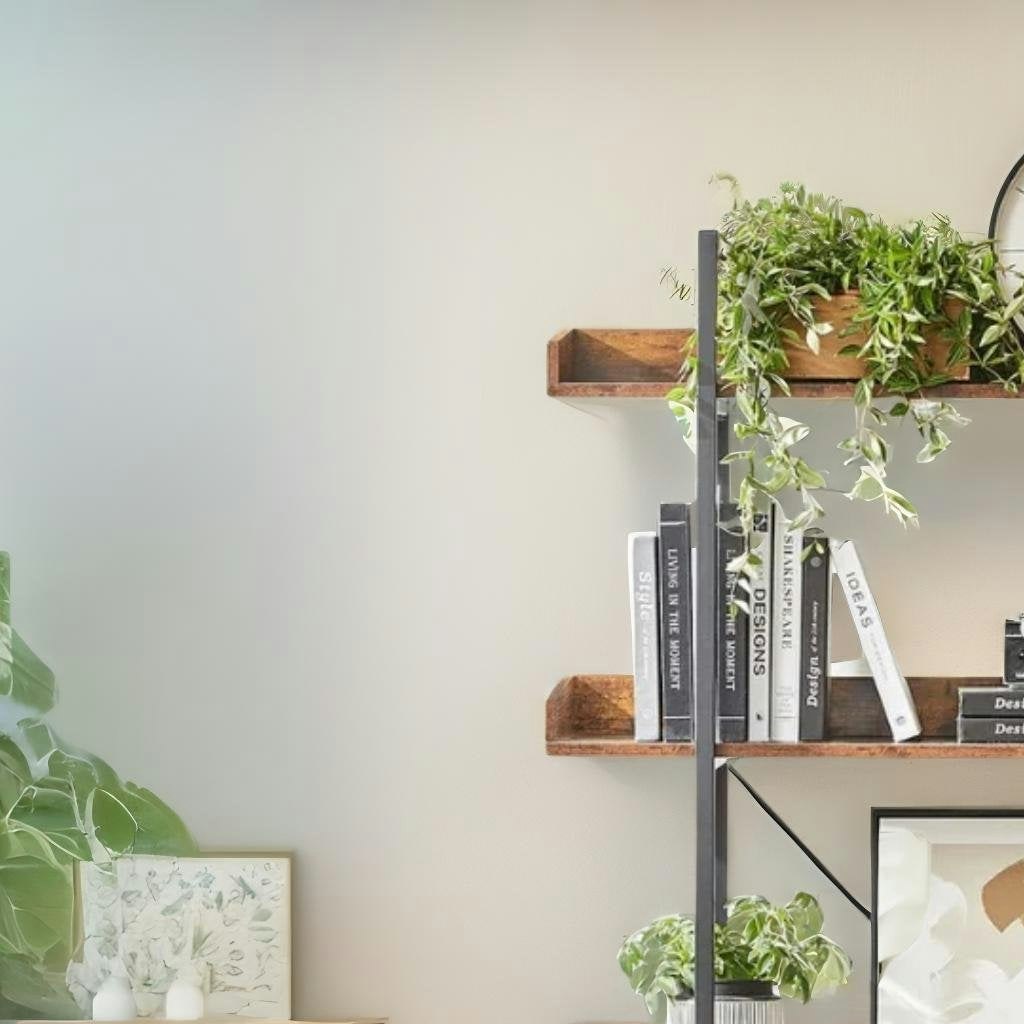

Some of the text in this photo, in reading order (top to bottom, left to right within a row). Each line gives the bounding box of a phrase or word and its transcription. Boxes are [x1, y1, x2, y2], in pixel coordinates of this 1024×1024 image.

[637, 571, 652, 621] Style
[668, 548, 680, 691] LIVING IN THE MOMENT
[782, 535, 793, 649] SHAKESPEARE
[846, 571, 874, 629] IDEAS
[753, 588, 766, 676] DESIGNS
[726, 641, 736, 691] MOMENT
[806, 656, 821, 707] Design
